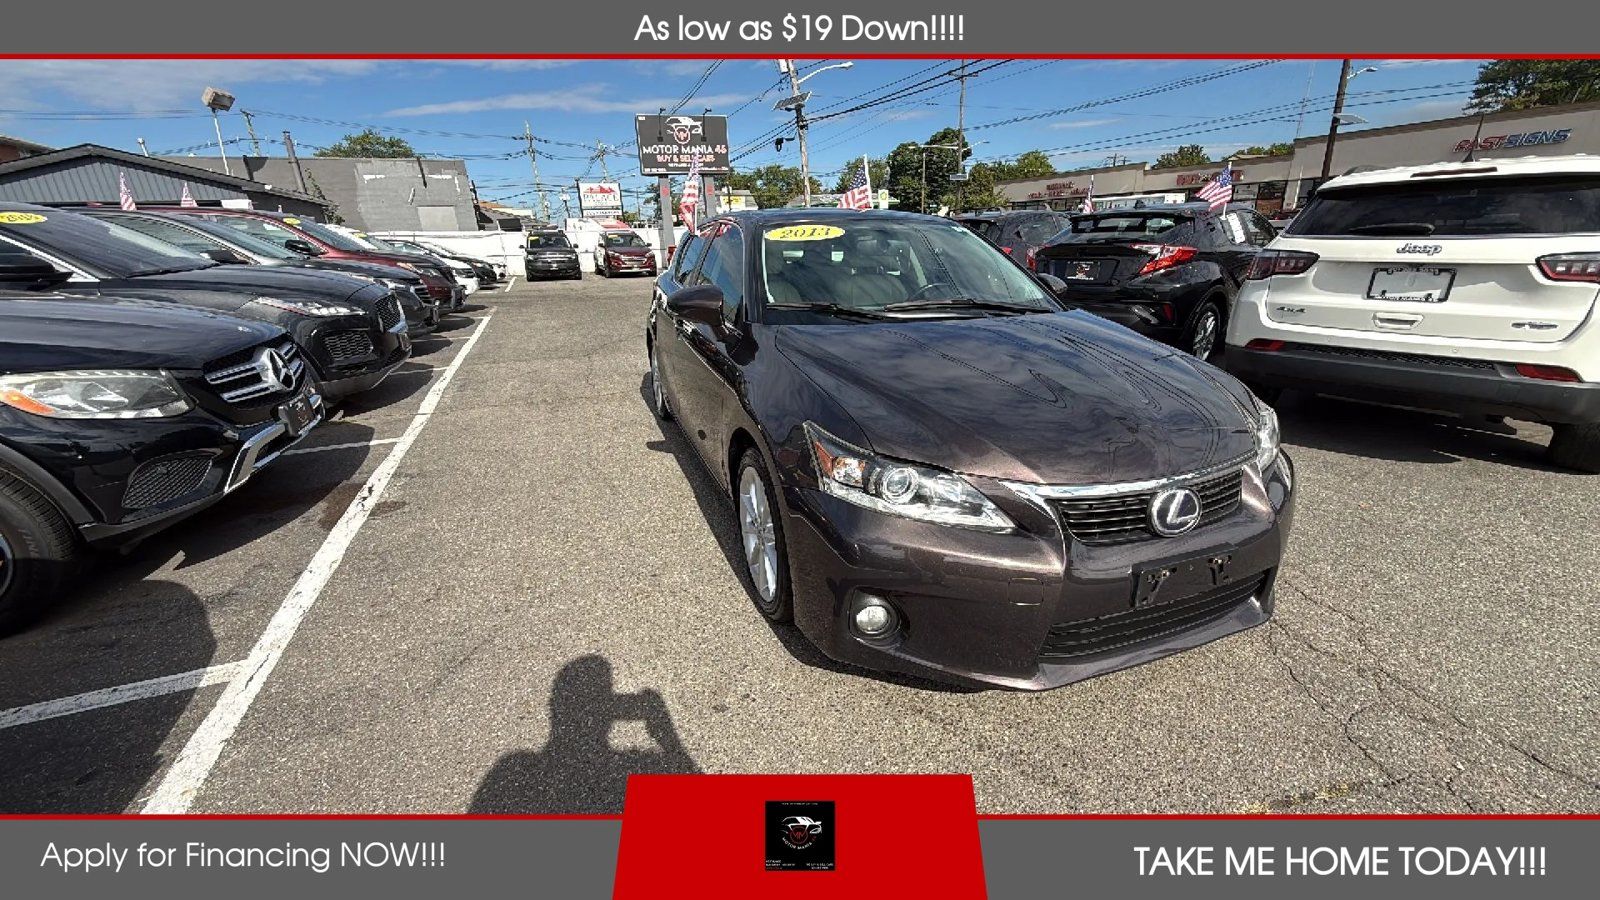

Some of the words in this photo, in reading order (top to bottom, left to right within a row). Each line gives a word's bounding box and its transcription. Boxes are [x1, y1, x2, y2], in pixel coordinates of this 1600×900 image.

[642, 144, 679, 154] MOTOR
[681, 144, 713, 154] MANIA
[1396, 243, 1442, 256] Jeep
